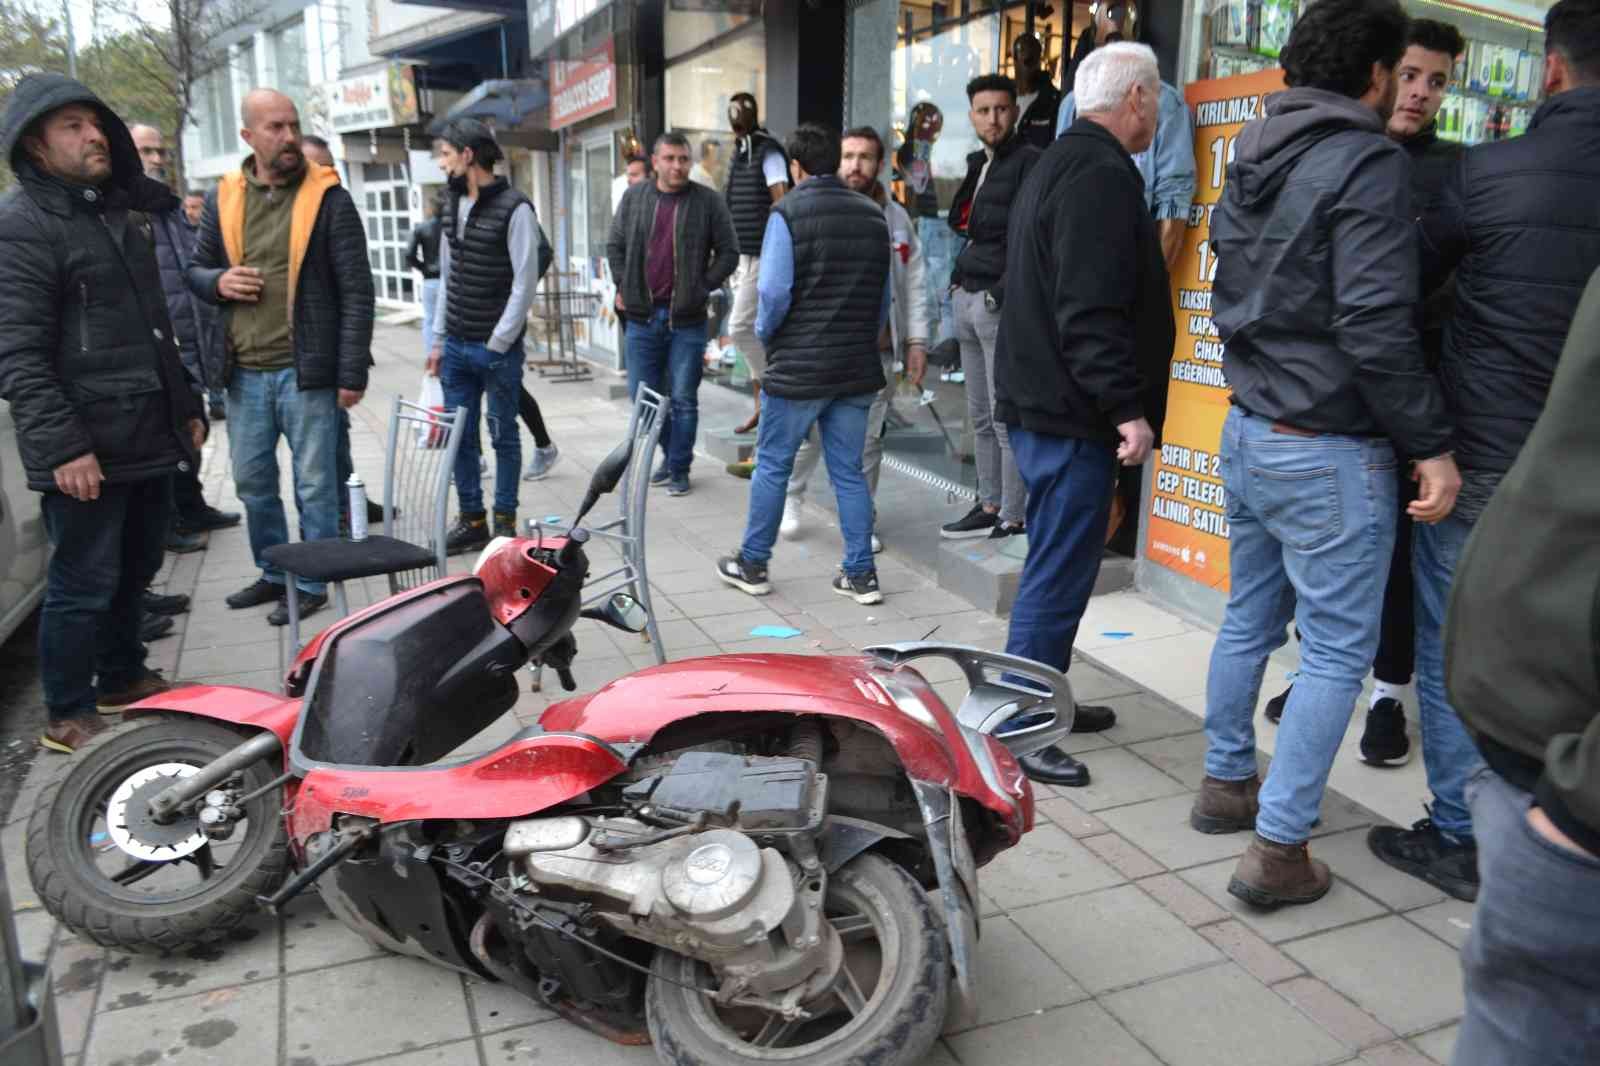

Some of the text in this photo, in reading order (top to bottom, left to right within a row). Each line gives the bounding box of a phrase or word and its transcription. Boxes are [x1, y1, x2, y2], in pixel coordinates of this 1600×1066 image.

[590, 67, 611, 104] SHOP
[1196, 95, 1259, 127] KIRILMAZ
[1161, 443, 1191, 470] SIFIR
[1194, 450, 1209, 474] VE
[1157, 470, 1226, 508] CEP TELEFO
[1152, 496, 1190, 526] ALINIR
